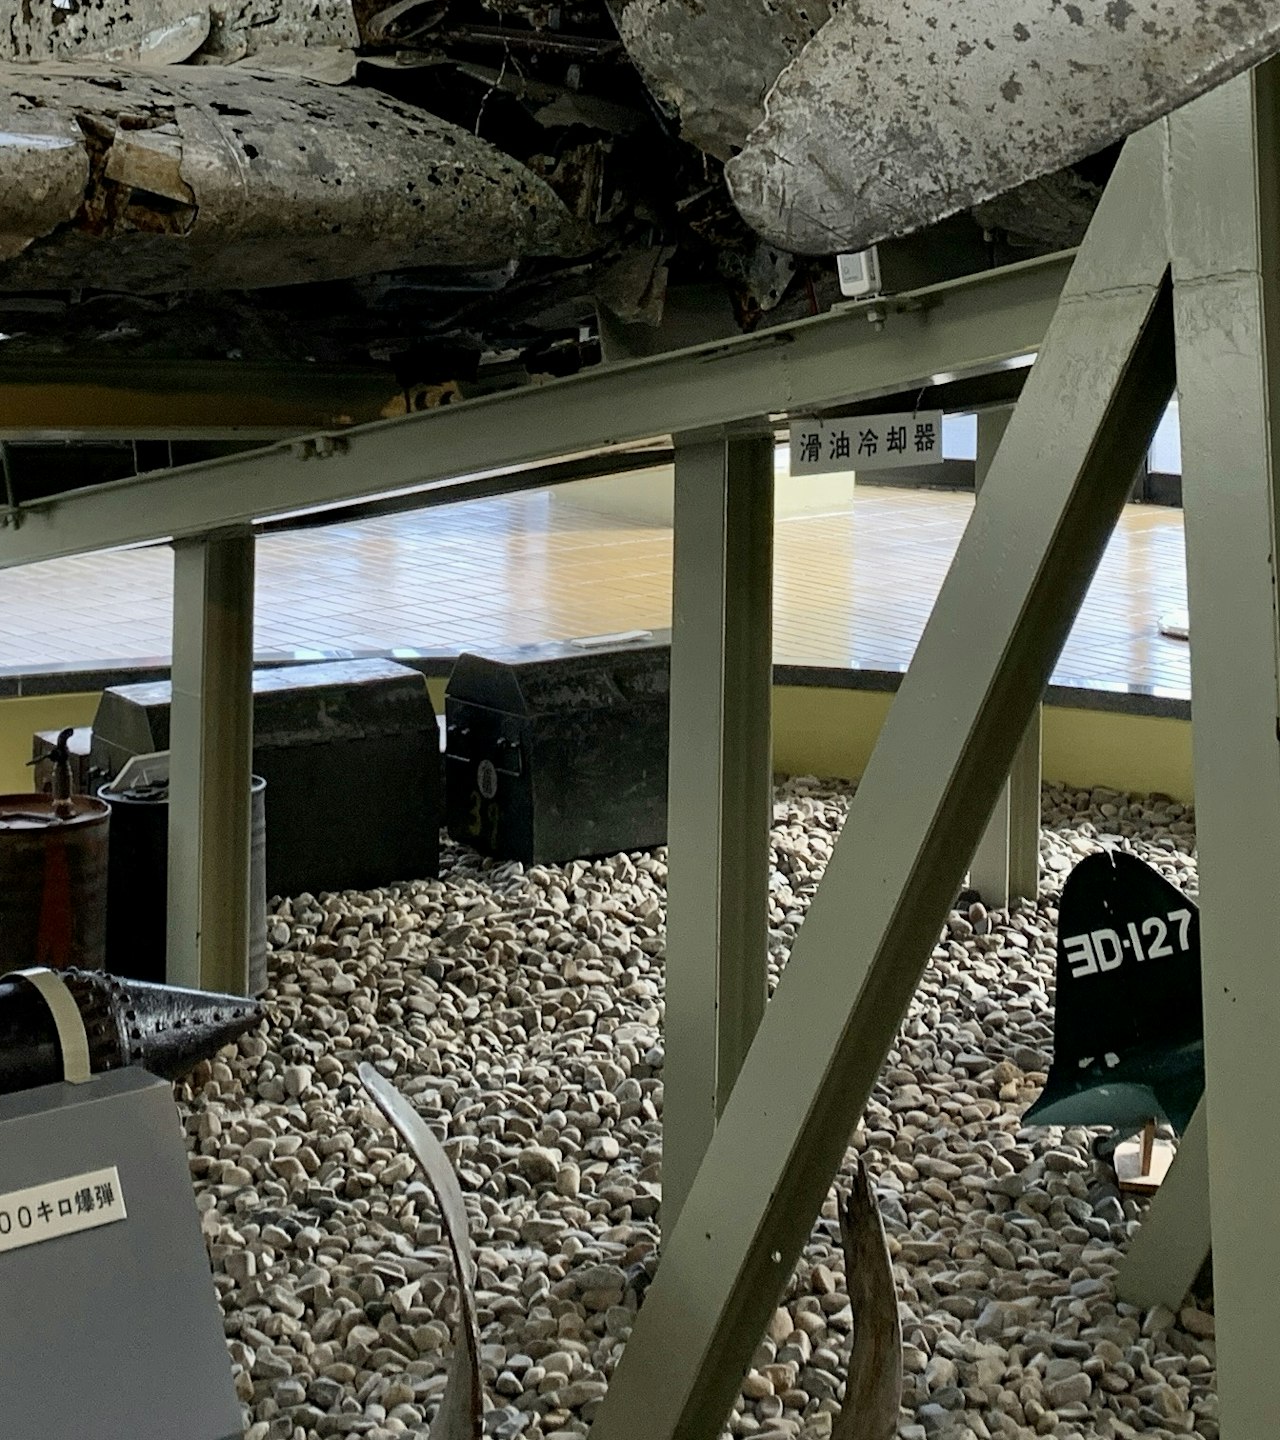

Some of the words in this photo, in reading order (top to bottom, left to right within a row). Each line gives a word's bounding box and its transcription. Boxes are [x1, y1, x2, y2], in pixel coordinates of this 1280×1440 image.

[799, 422, 936, 463] 滑油冷却器
